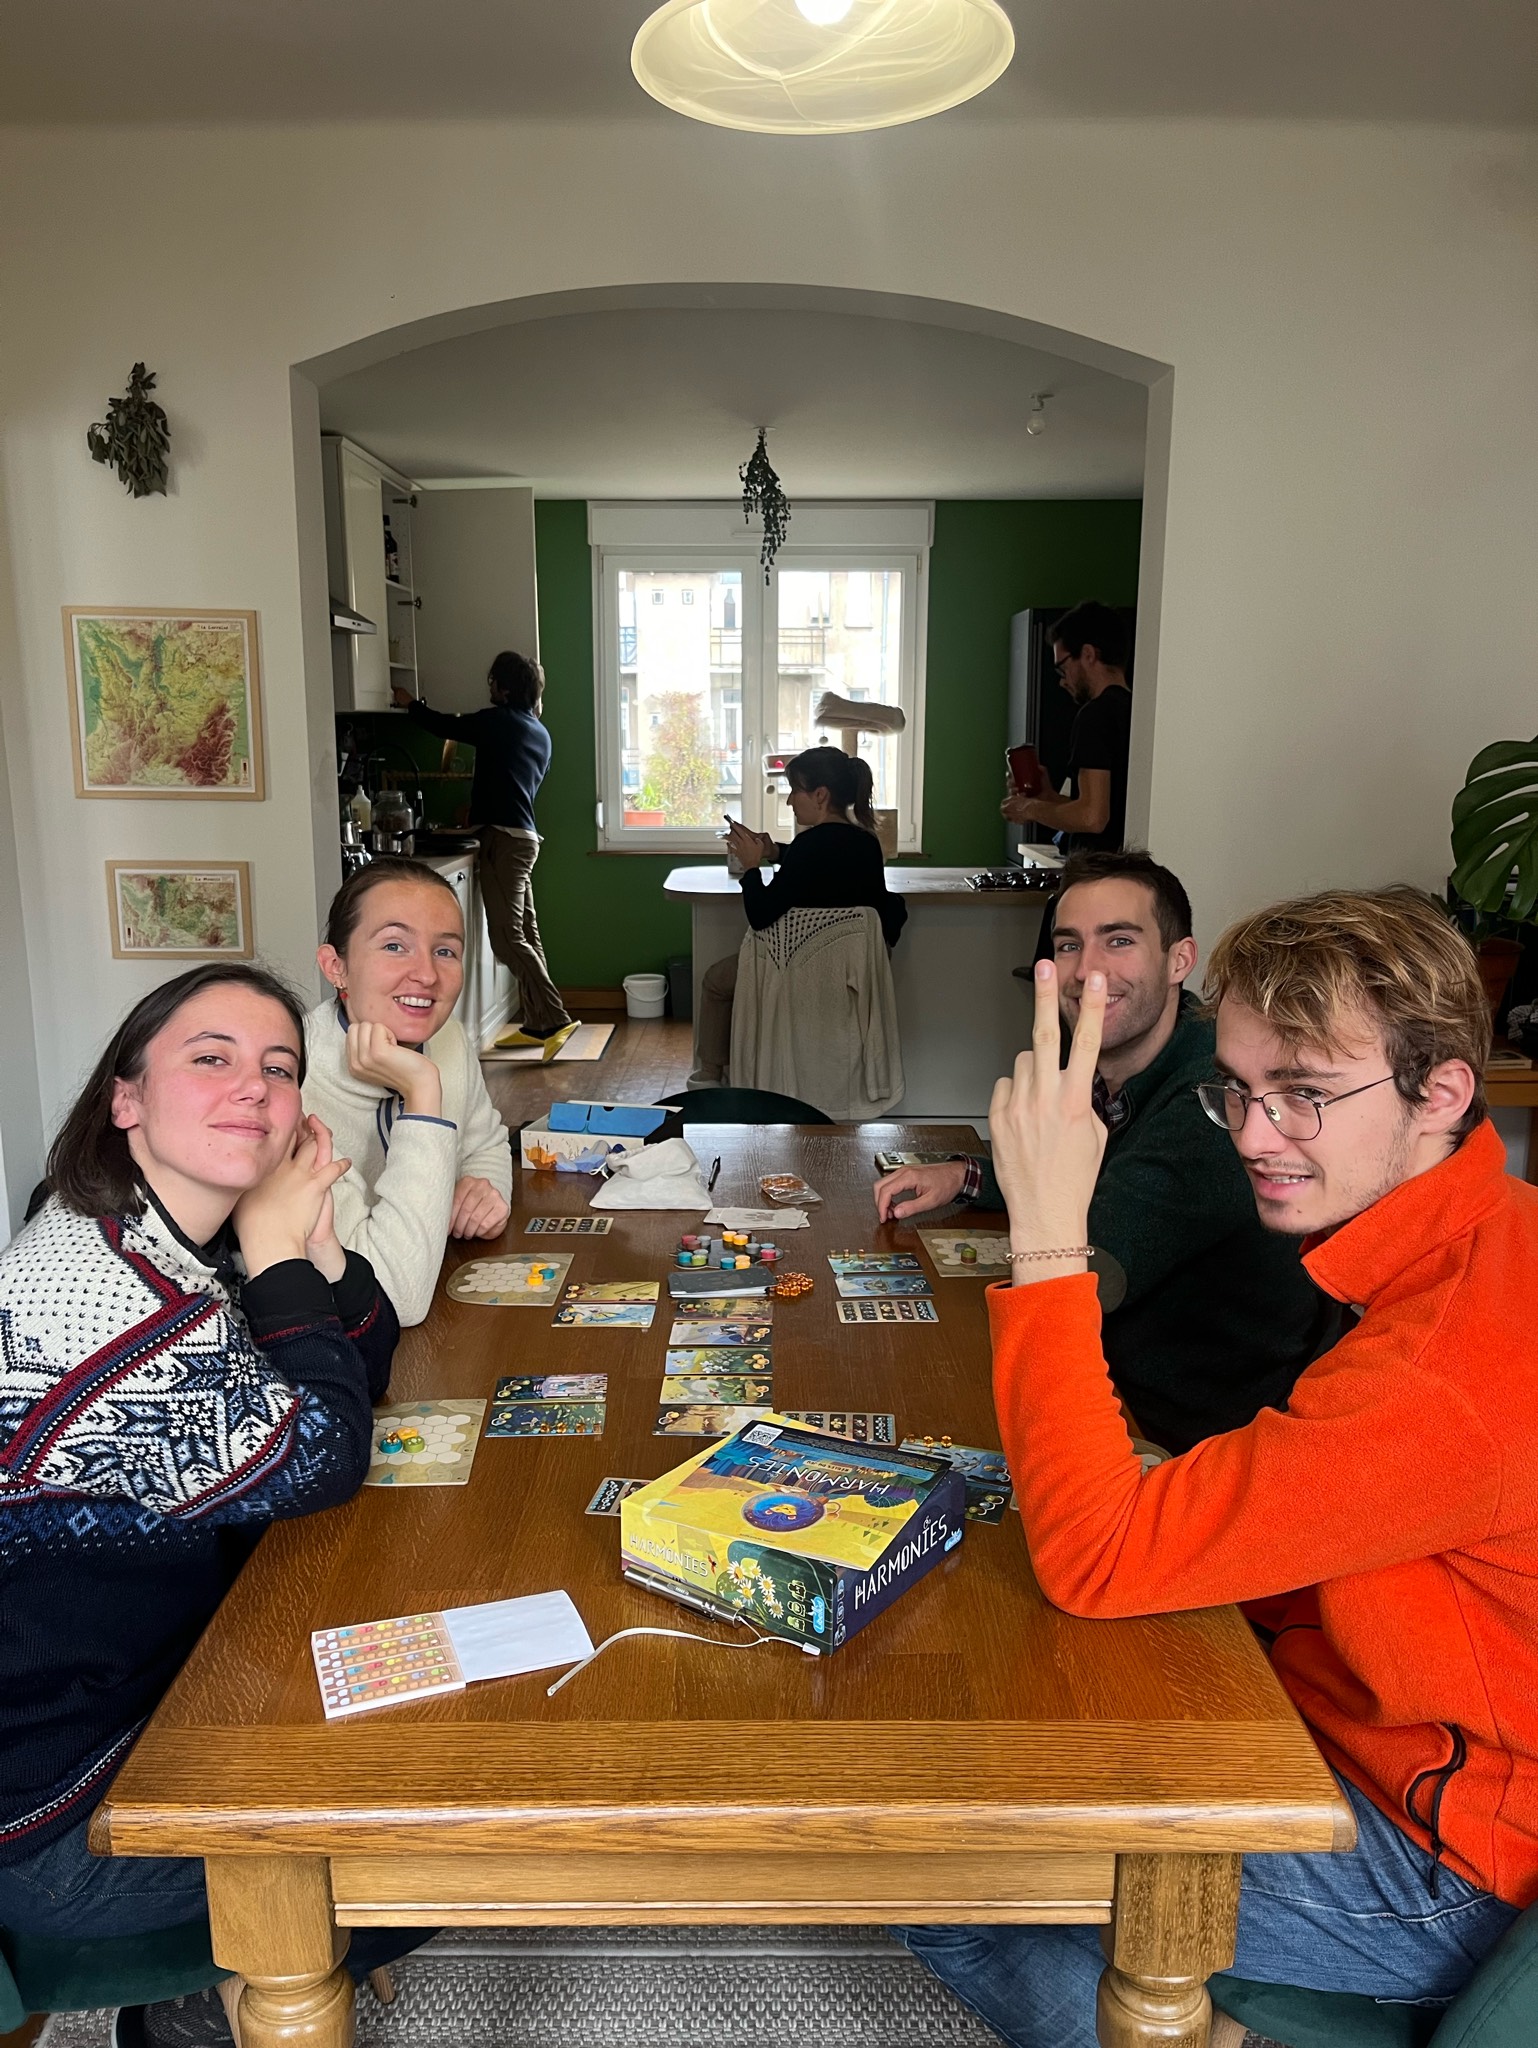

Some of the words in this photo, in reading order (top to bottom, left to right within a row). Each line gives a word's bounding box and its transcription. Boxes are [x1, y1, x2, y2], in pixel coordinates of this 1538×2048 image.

[746, 1456, 891, 1495] HARMONIES
[629, 1532, 709, 1578] HARMONIES
[855, 1514, 948, 1611] HARMONIES
